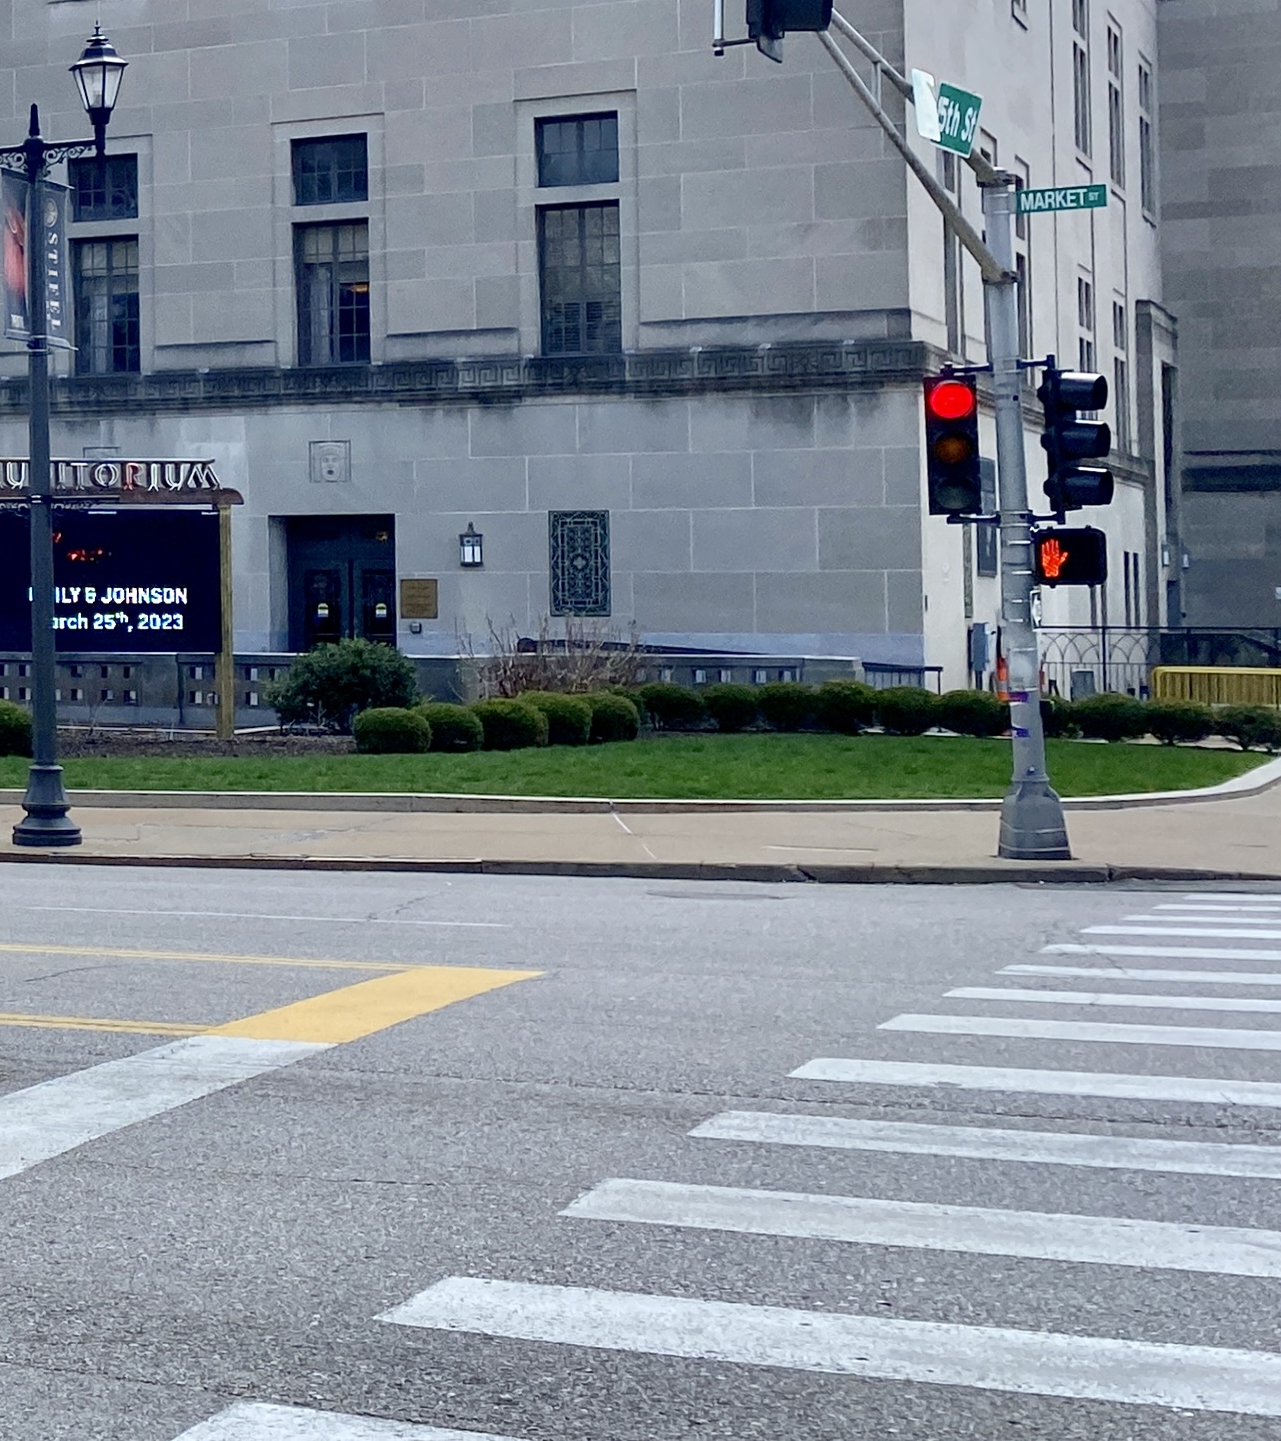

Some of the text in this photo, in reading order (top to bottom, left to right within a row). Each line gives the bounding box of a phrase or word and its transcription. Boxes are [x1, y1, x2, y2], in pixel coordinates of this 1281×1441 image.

[961, 107, 977, 143] St
[1020, 188, 1099, 211] MARKET ST
[48, 232, 61, 330] STIFEL
[28, 586, 81, 604] ILY
[100, 587, 188, 605] JOHNSON
[52, 611, 183, 633] arch 25th, 2023
